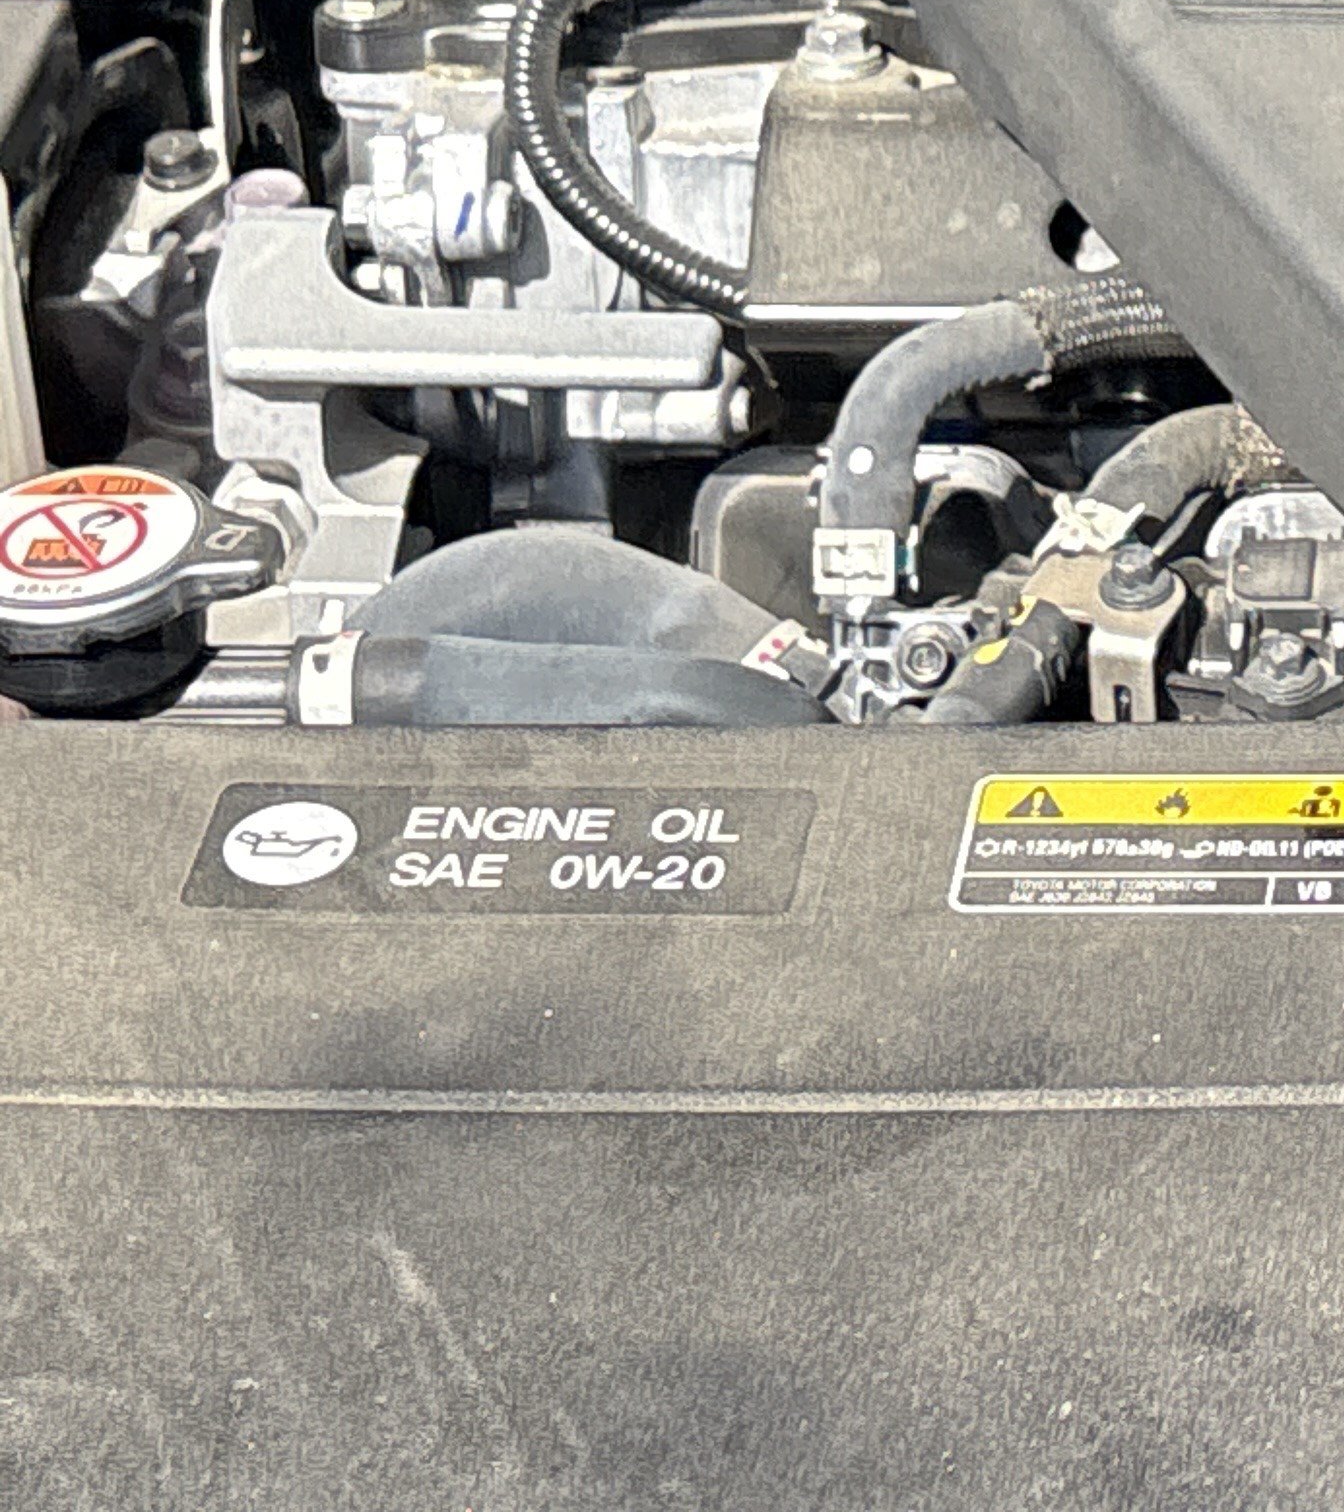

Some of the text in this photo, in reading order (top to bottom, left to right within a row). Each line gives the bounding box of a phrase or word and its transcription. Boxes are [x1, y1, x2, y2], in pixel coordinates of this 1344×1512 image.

[402, 806, 740, 843] ENGINE OIL
[389, 852, 726, 890] SAE 0W-20
[1012, 879, 1217, 891] TOYOTA MOTOR CORPORATION
